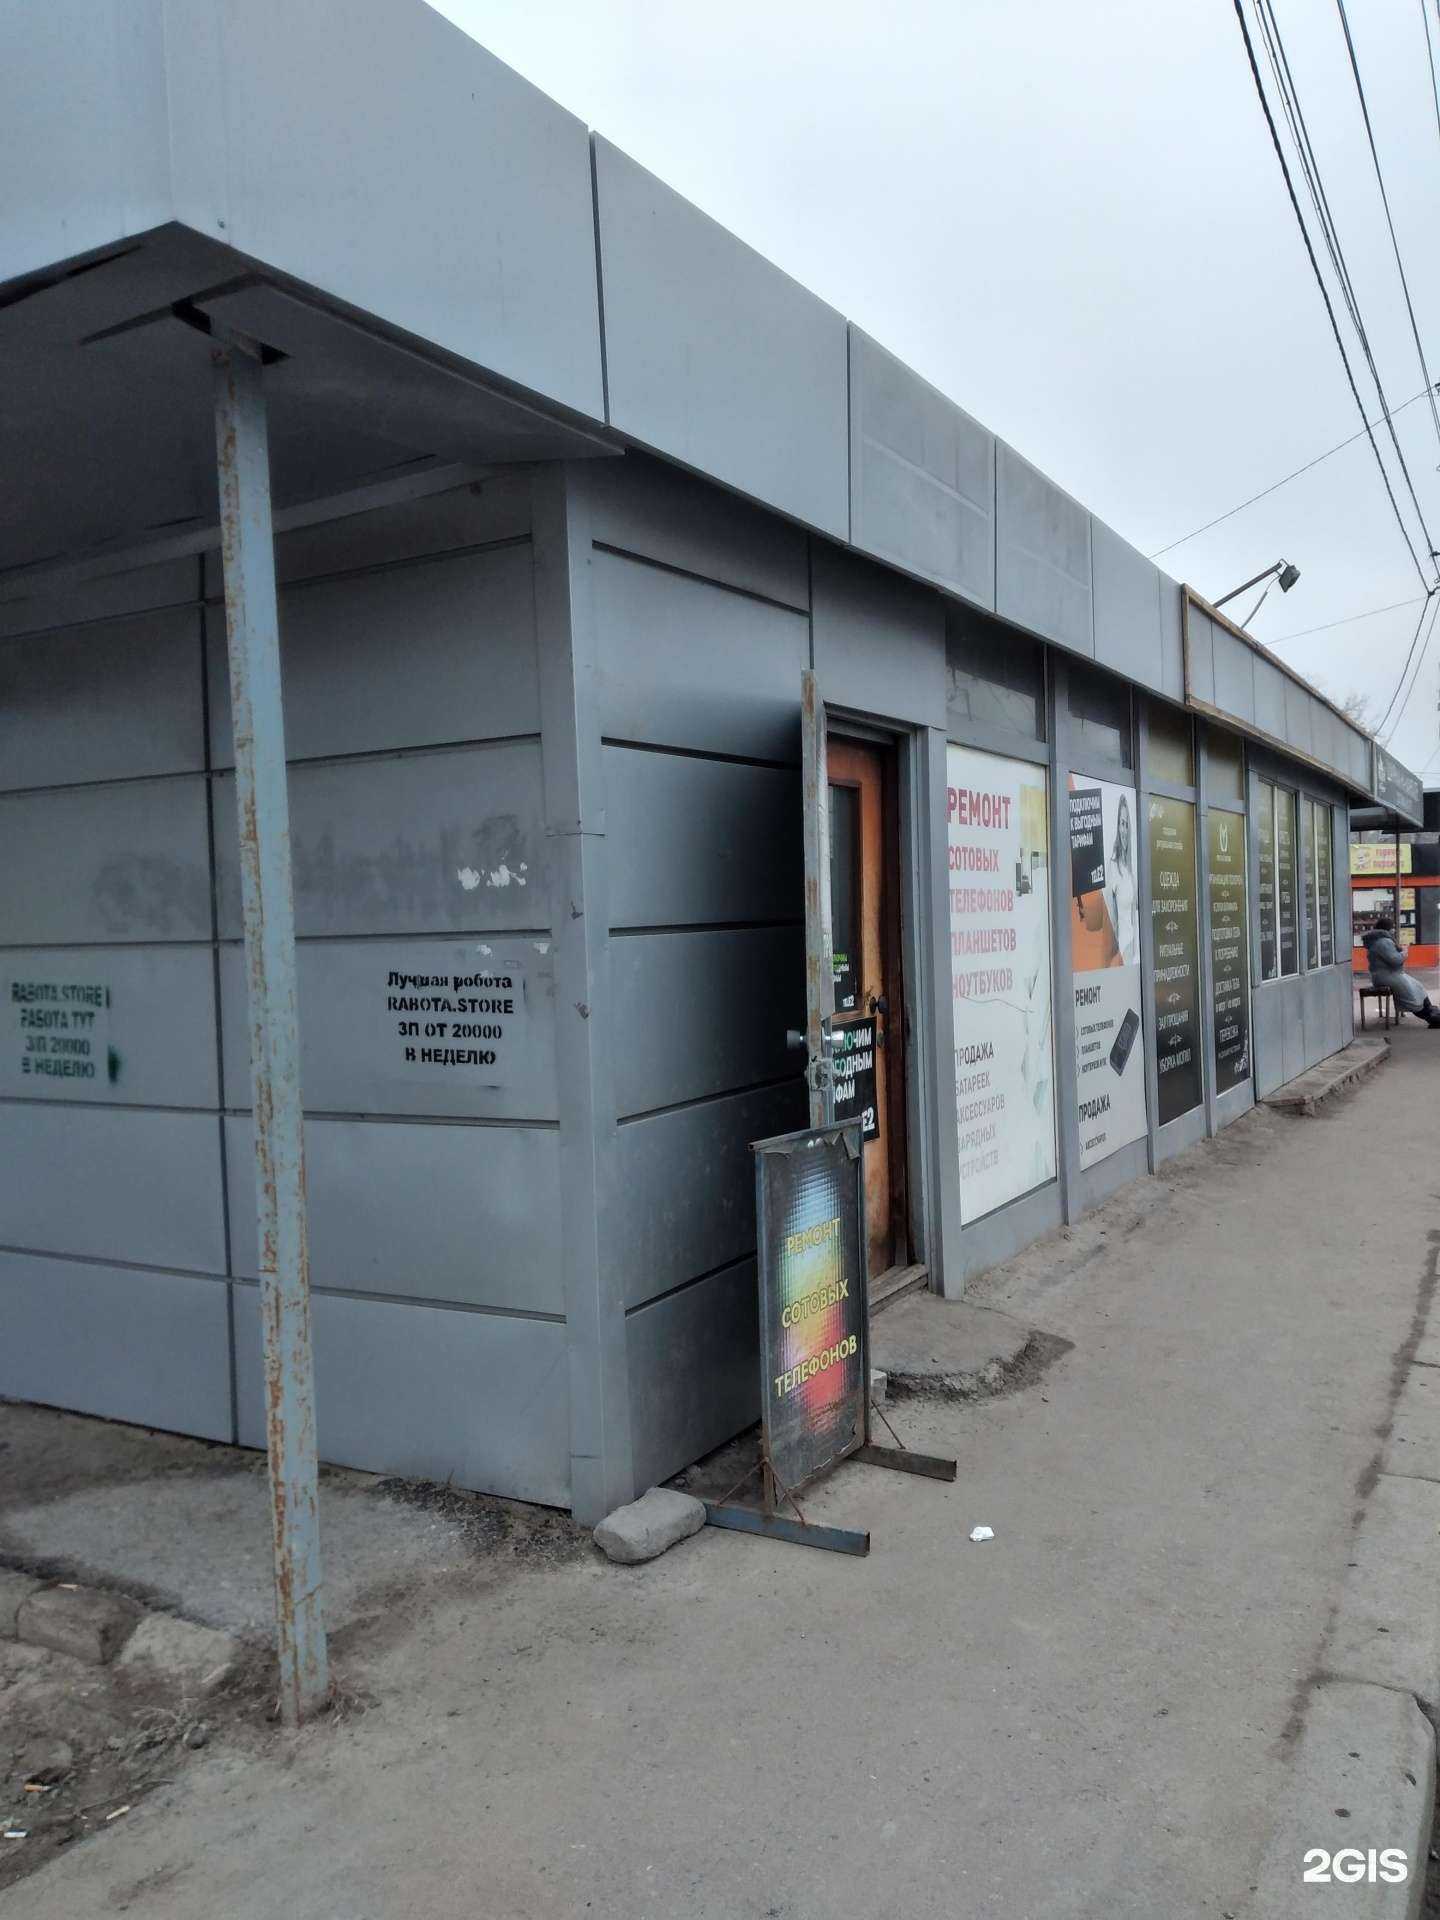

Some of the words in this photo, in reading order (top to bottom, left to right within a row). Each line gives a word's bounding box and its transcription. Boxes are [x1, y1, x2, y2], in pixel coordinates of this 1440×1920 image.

[946, 787, 1012, 829] РЕМОНТ
[948, 846, 999, 872] СОТОВЫХ
[949, 888, 1014, 913] ТЕЛЕФОНОВ
[951, 928, 1017, 955] ПЛАНШЕТОВ
[952, 967, 1014, 999] НОУТБУКОВ
[1075, 985, 1101, 1007] РЕМОНТ
[398, 1021, 420, 1037] ЗП
[425, 1022, 448, 1038] ОТ
[452, 1023, 503, 1040] 20000
[405, 1047, 417, 1062] В
[421, 1047, 497, 1067] НЕДЕЛЮ
[954, 1042, 995, 1068] ПРОДАЖА
[34, 1058, 96, 1079] НЕДЕЛЮ
[954, 1072, 991, 1096] БАТАРЕЕК
[1079, 1094, 1111, 1123] ПРОДАЖА
[786, 1218, 841, 1257] РЕМОНТ
[781, 1278, 849, 1329] СОТОВЫХ
[774, 1334, 857, 1399] ТЕЛЕФОНОВ
